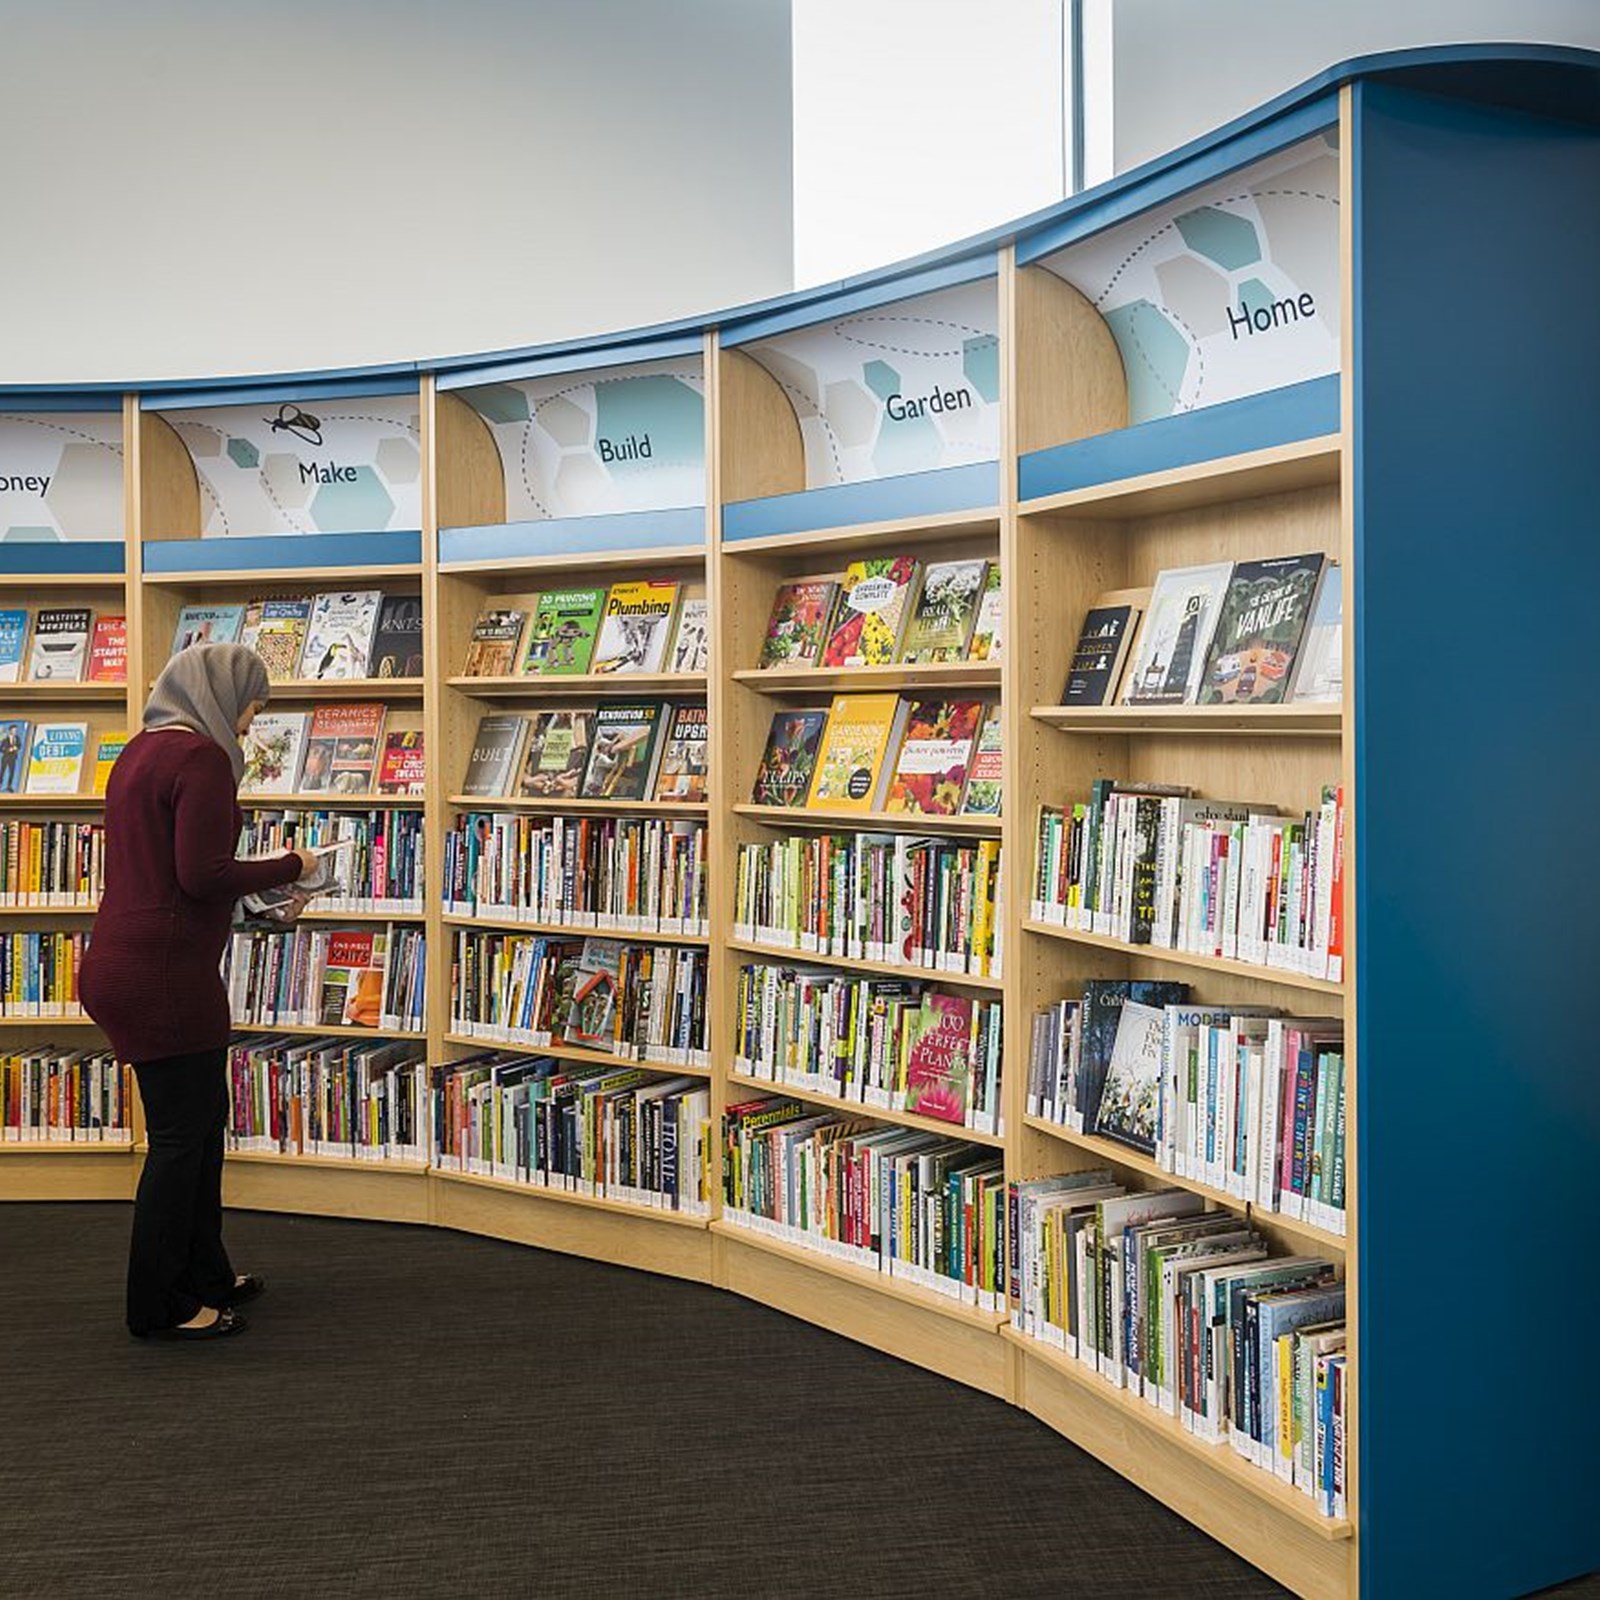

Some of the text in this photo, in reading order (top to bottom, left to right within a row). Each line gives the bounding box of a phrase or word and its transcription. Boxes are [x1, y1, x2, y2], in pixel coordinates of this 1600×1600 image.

[1226, 292, 1315, 340] Home
[886, 385, 972, 422] Garden
[599, 436, 652, 462] Build
[299, 461, 357, 484] Make
[0, 476, 51, 498] oney
[41, 613, 88, 622] EINSTEIN'S
[608, 598, 671, 618] Plumbing
[1236, 594, 1299, 639] VANLIFE
[39, 621, 86, 631] MONSTERS
[381, 618, 423, 631] KNITS
[316, 707, 378, 719] CERAMICS
[473, 747, 513, 762] BUILT
[762, 769, 805, 784] TULIPS
[1177, 1012, 1231, 1027] MODER
[920, 1047, 966, 1070] PLANTS
[1297, 1070, 1309, 1117] PRINTS
[743, 1103, 800, 1130] Perennials
[1336, 1091, 1345, 1136] STYLING
[1332, 1157, 1342, 1202] SALVAGE
